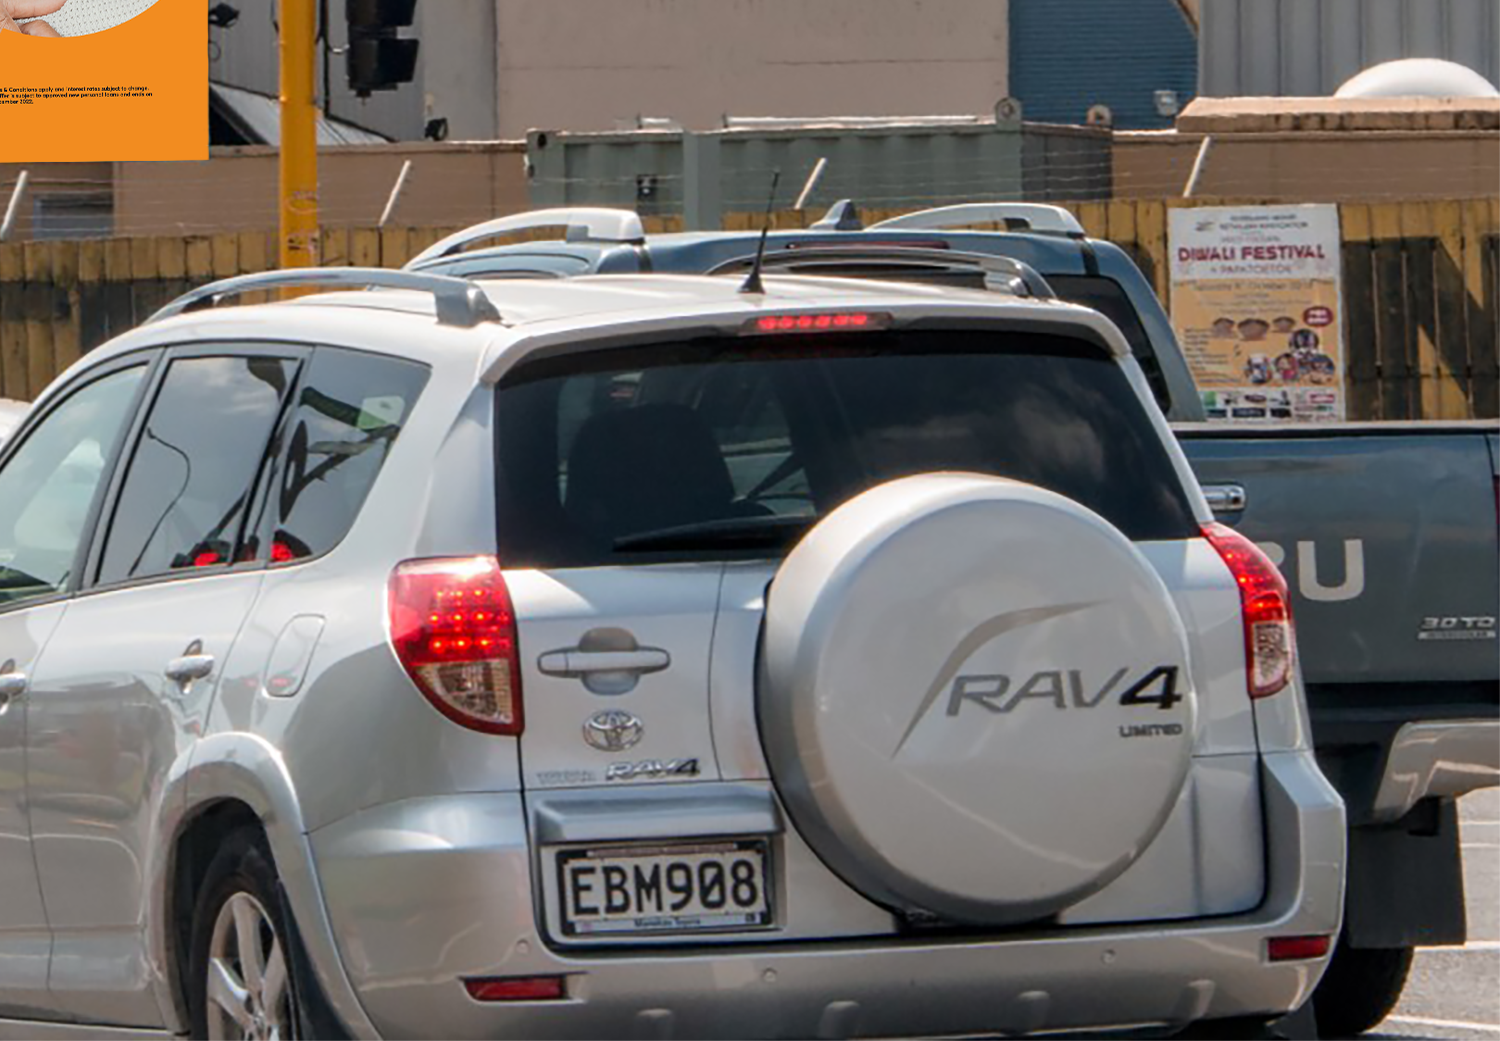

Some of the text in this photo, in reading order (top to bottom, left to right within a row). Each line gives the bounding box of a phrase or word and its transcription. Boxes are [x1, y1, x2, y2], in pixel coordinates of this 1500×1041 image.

[1177, 244, 1326, 262] DIWALI FESTIVAL
[946, 665, 1183, 716] RAV4
[1118, 723, 1183, 738] LIMITED
[605, 757, 702, 782] RAV4
[570, 859, 758, 916] EBM908
